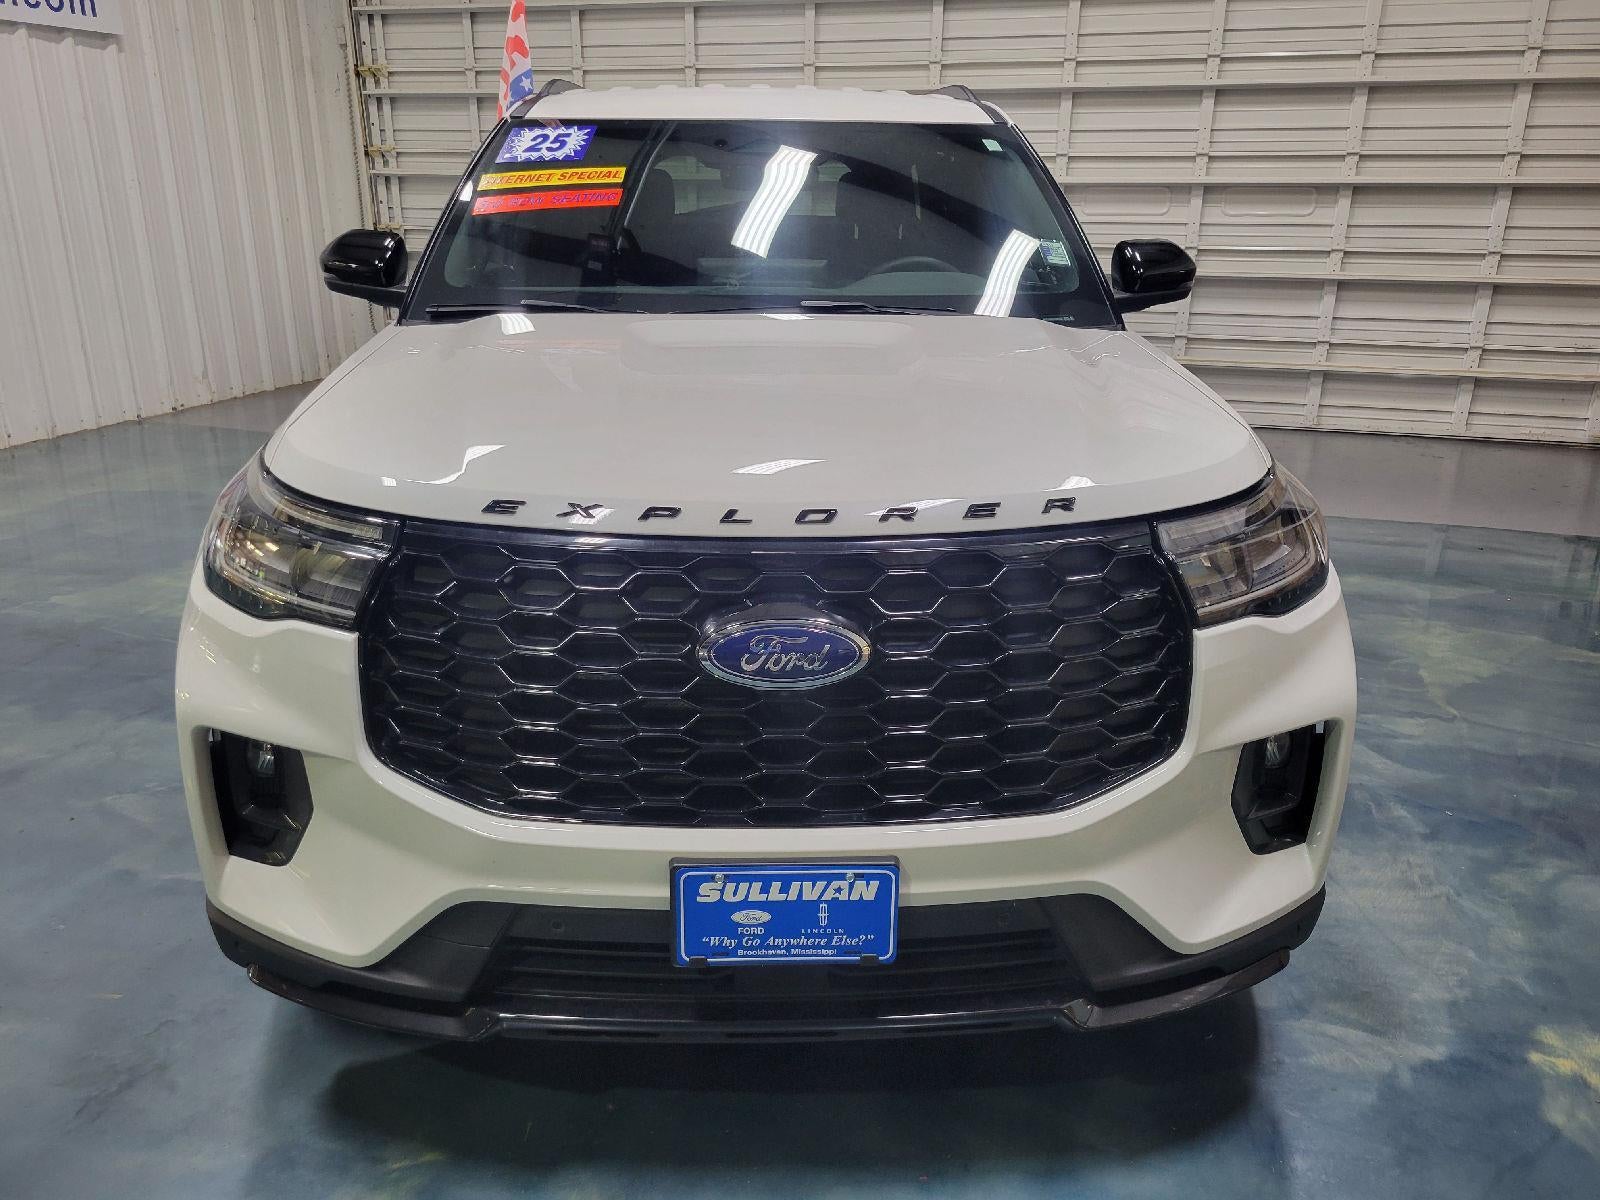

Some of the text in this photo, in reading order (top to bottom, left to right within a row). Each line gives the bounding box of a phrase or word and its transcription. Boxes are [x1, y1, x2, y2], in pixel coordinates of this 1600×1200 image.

[522, 132, 573, 153] 25
[559, 169, 622, 181] SPECIAL
[551, 192, 618, 205] SEATING
[481, 495, 1077, 525] EXPLORER
[740, 634, 831, 672] Ford
[696, 880, 880, 903] SULLIVAN
[737, 927, 765, 936] FORD
[742, 936, 761, 947] Go
[765, 936, 828, 949] Anywhere
[737, 948, 837, 957] Brookhaven, Mississippi
